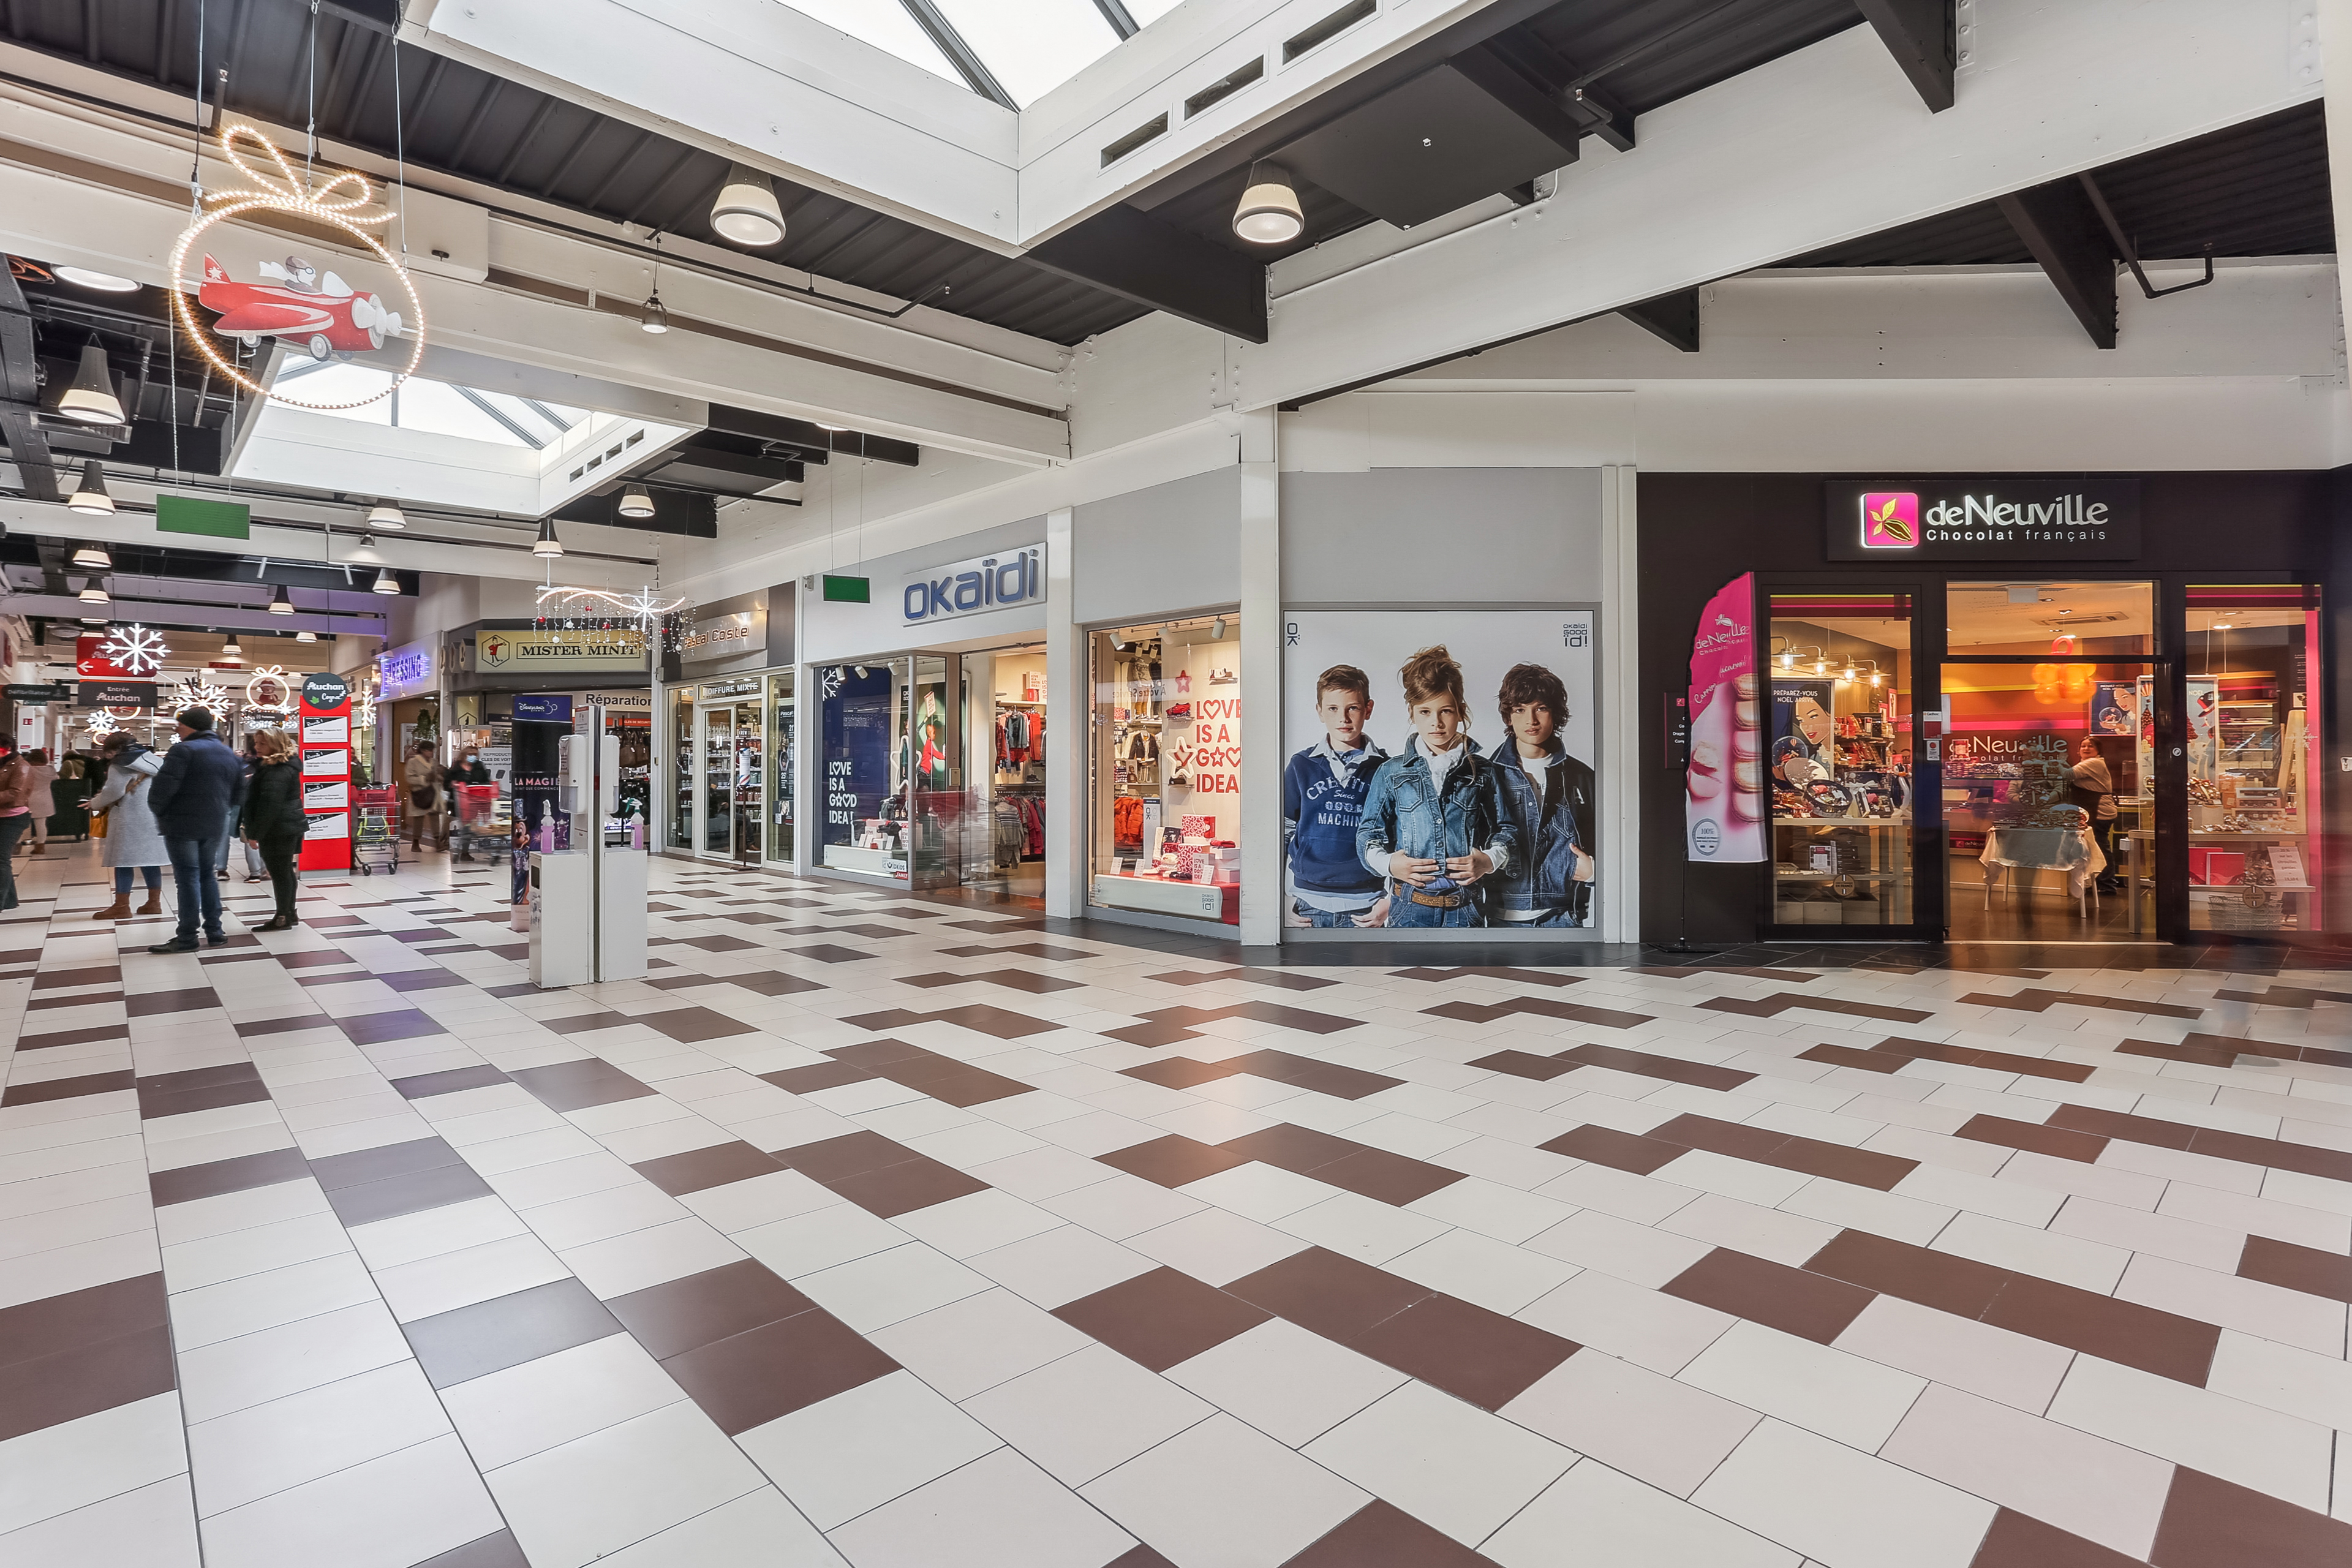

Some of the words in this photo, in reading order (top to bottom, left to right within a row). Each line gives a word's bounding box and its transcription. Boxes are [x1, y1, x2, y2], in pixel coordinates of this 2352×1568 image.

[1926, 494, 2108, 526] deNeuville
[1926, 529, 2014, 541] Chocolat
[2026, 529, 2106, 543] français
[712, 626, 748, 643] Coste
[521, 645, 582, 656] MISTER
[587, 645, 636, 655] MINIT
[306, 682, 344, 690] Auchan
[704, 685, 735, 695] OIFFURE
[737, 682, 759, 692] MIXTE
[96, 692, 141, 703] Auchan
[1196, 724, 1212, 743] IS
[1217, 724, 1231, 743] A
[514, 777, 524, 786] LA
[526, 777, 560, 786] MAGIE
[829, 777, 837, 791] IS
[838, 777, 845, 791] A
